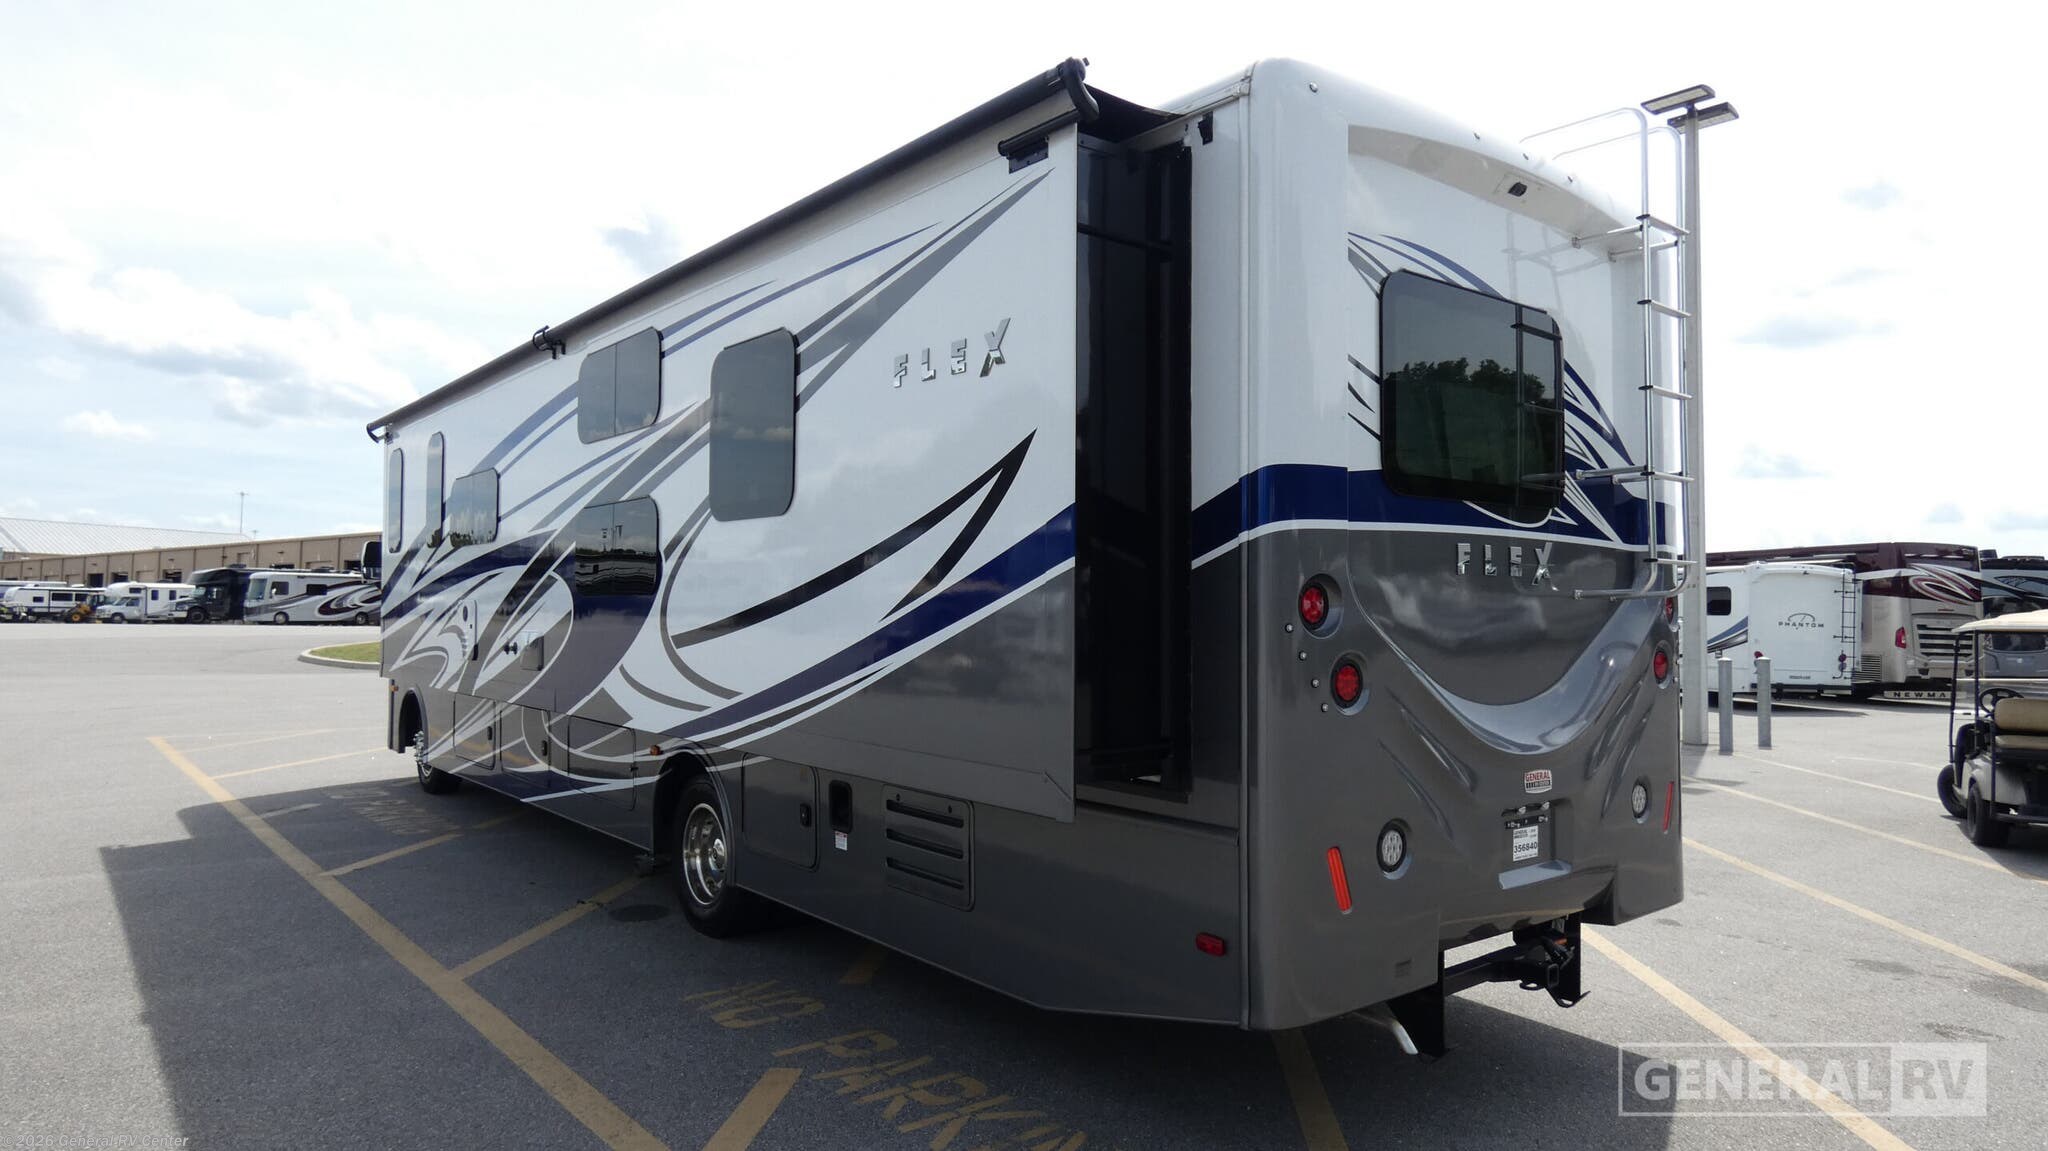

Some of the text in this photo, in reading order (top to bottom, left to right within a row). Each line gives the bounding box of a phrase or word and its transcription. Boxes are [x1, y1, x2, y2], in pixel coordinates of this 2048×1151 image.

[893, 317, 1011, 389] FLEX
[1457, 542, 1553, 586] FLEX
[1778, 621, 1825, 629] PHANTOM
[1526, 771, 1550, 781] GENERAL
[1513, 841, 1538, 854] 356840
[683, 980, 825, 1029] NO
